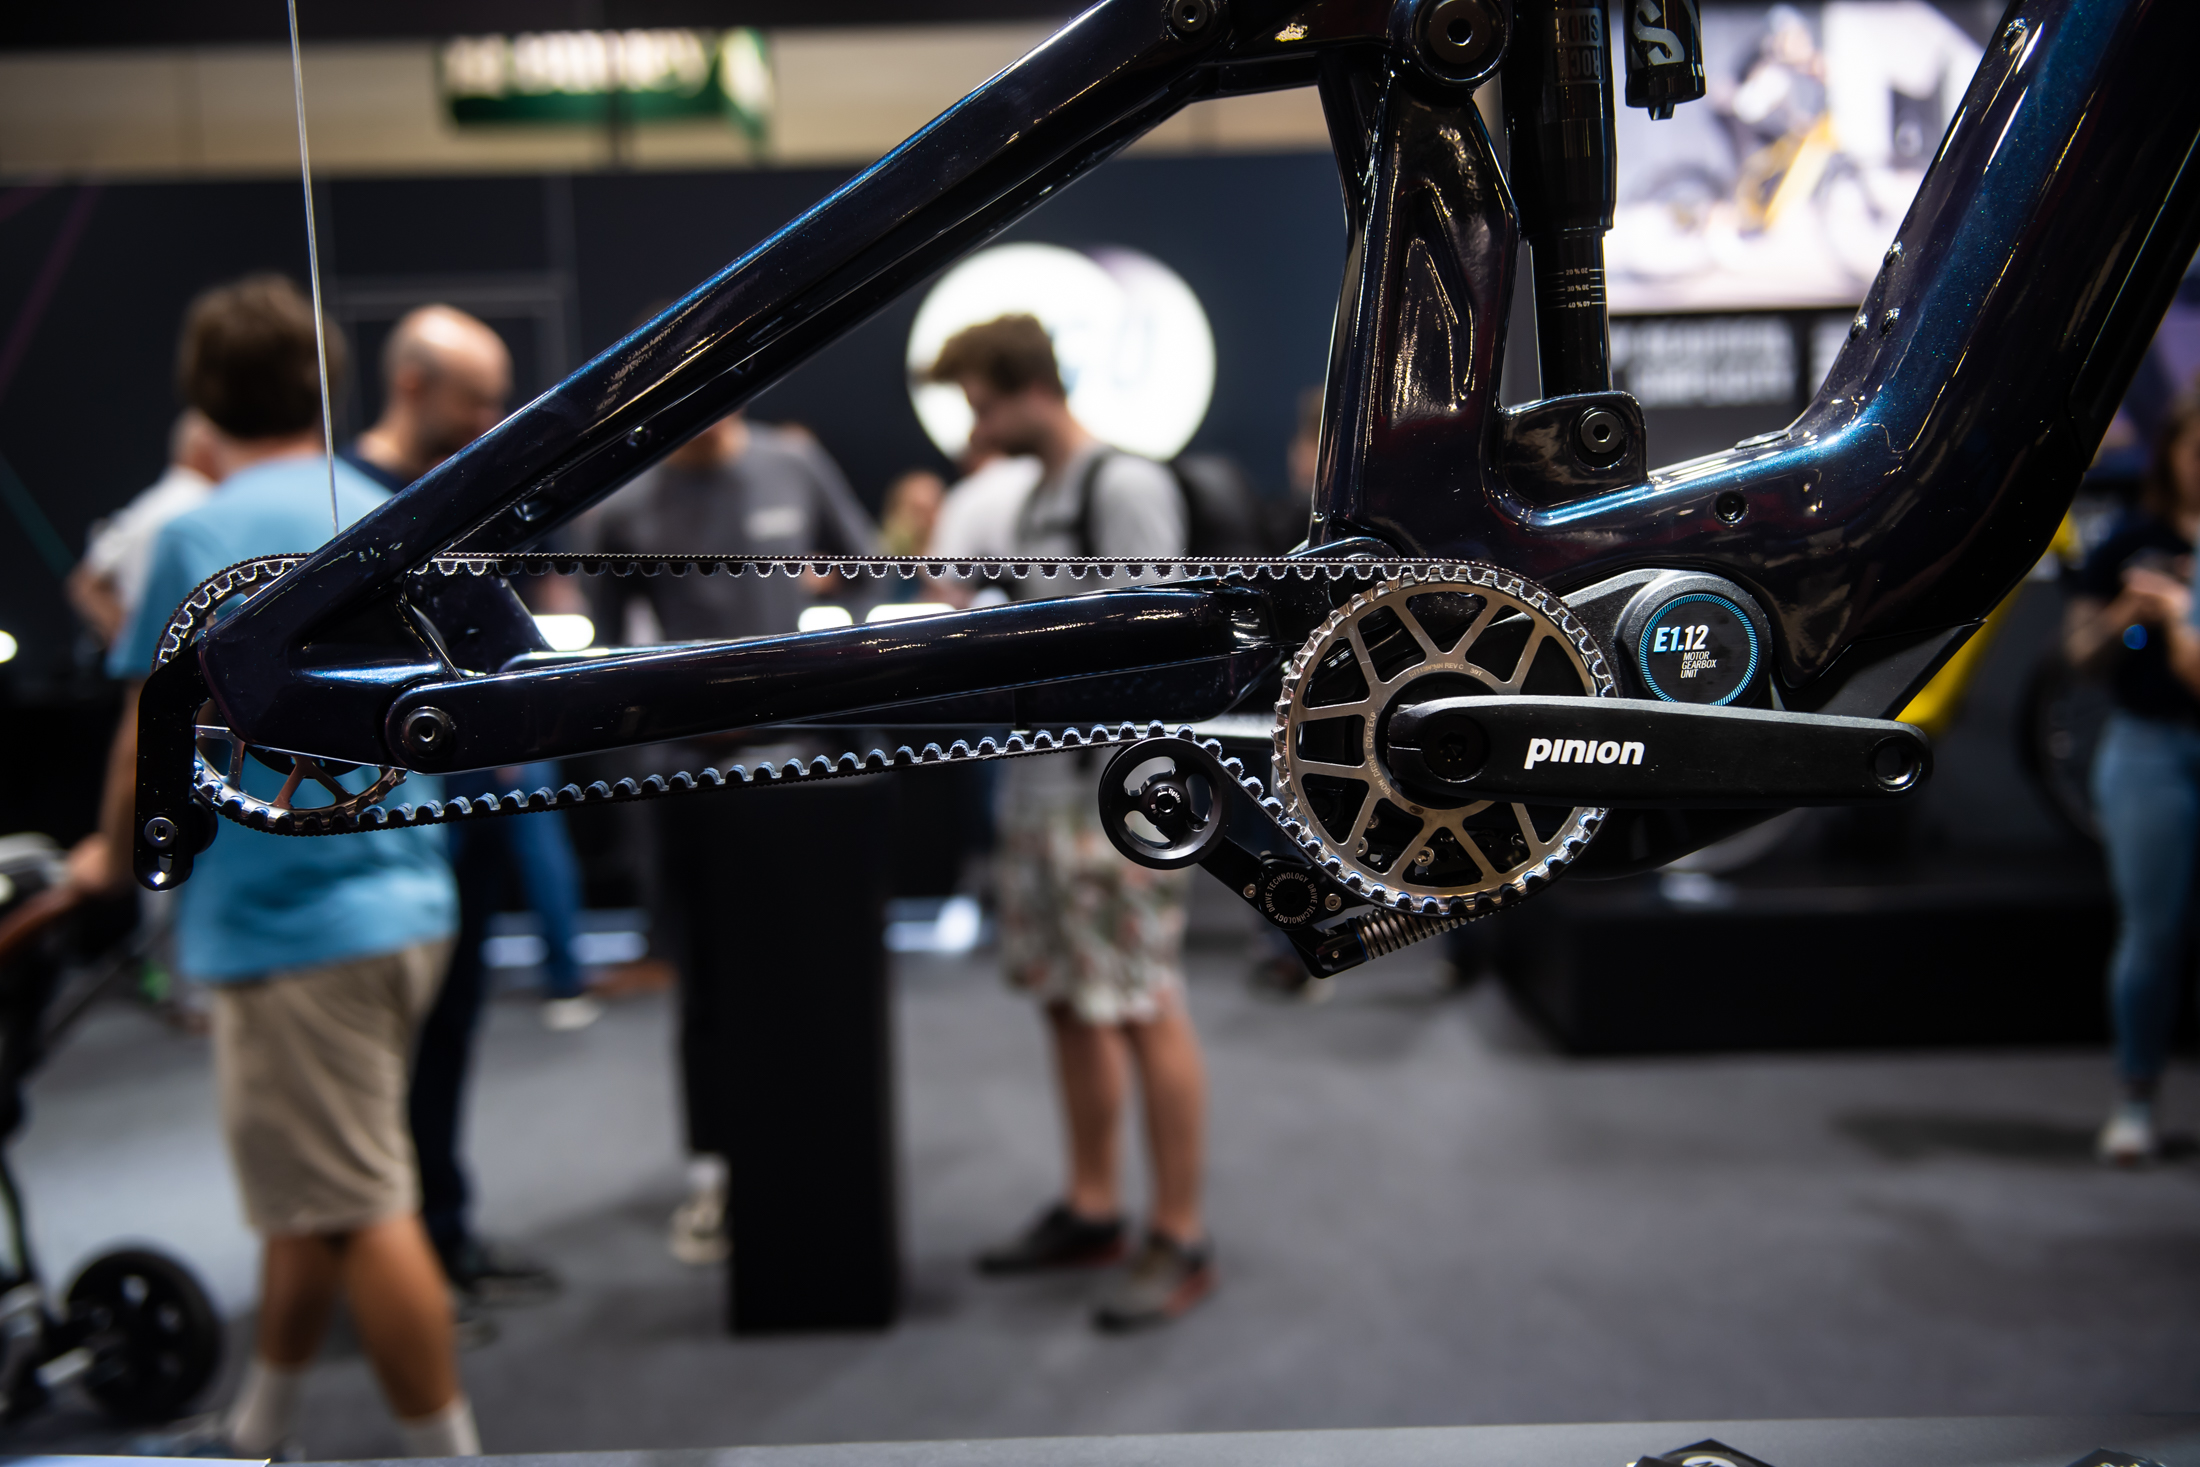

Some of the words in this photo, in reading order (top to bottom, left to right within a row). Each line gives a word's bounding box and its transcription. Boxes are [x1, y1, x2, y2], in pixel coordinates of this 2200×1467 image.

[1653, 625, 1710, 653] E1.12
[1681, 659, 1717, 670] GEARBOX
[1683, 651, 1710, 661] MOTOR
[1680, 669, 1699, 679] UNIT
[1523, 738, 1645, 770] pinion
[1366, 754, 1381, 778] DRIVE
[1266, 871, 1309, 891] TECHNOLOGY
[1264, 891, 1276, 913] DRIVE
[1307, 883, 1318, 904] DRIVE
[1273, 905, 1316, 924] TECHNOLOGY
